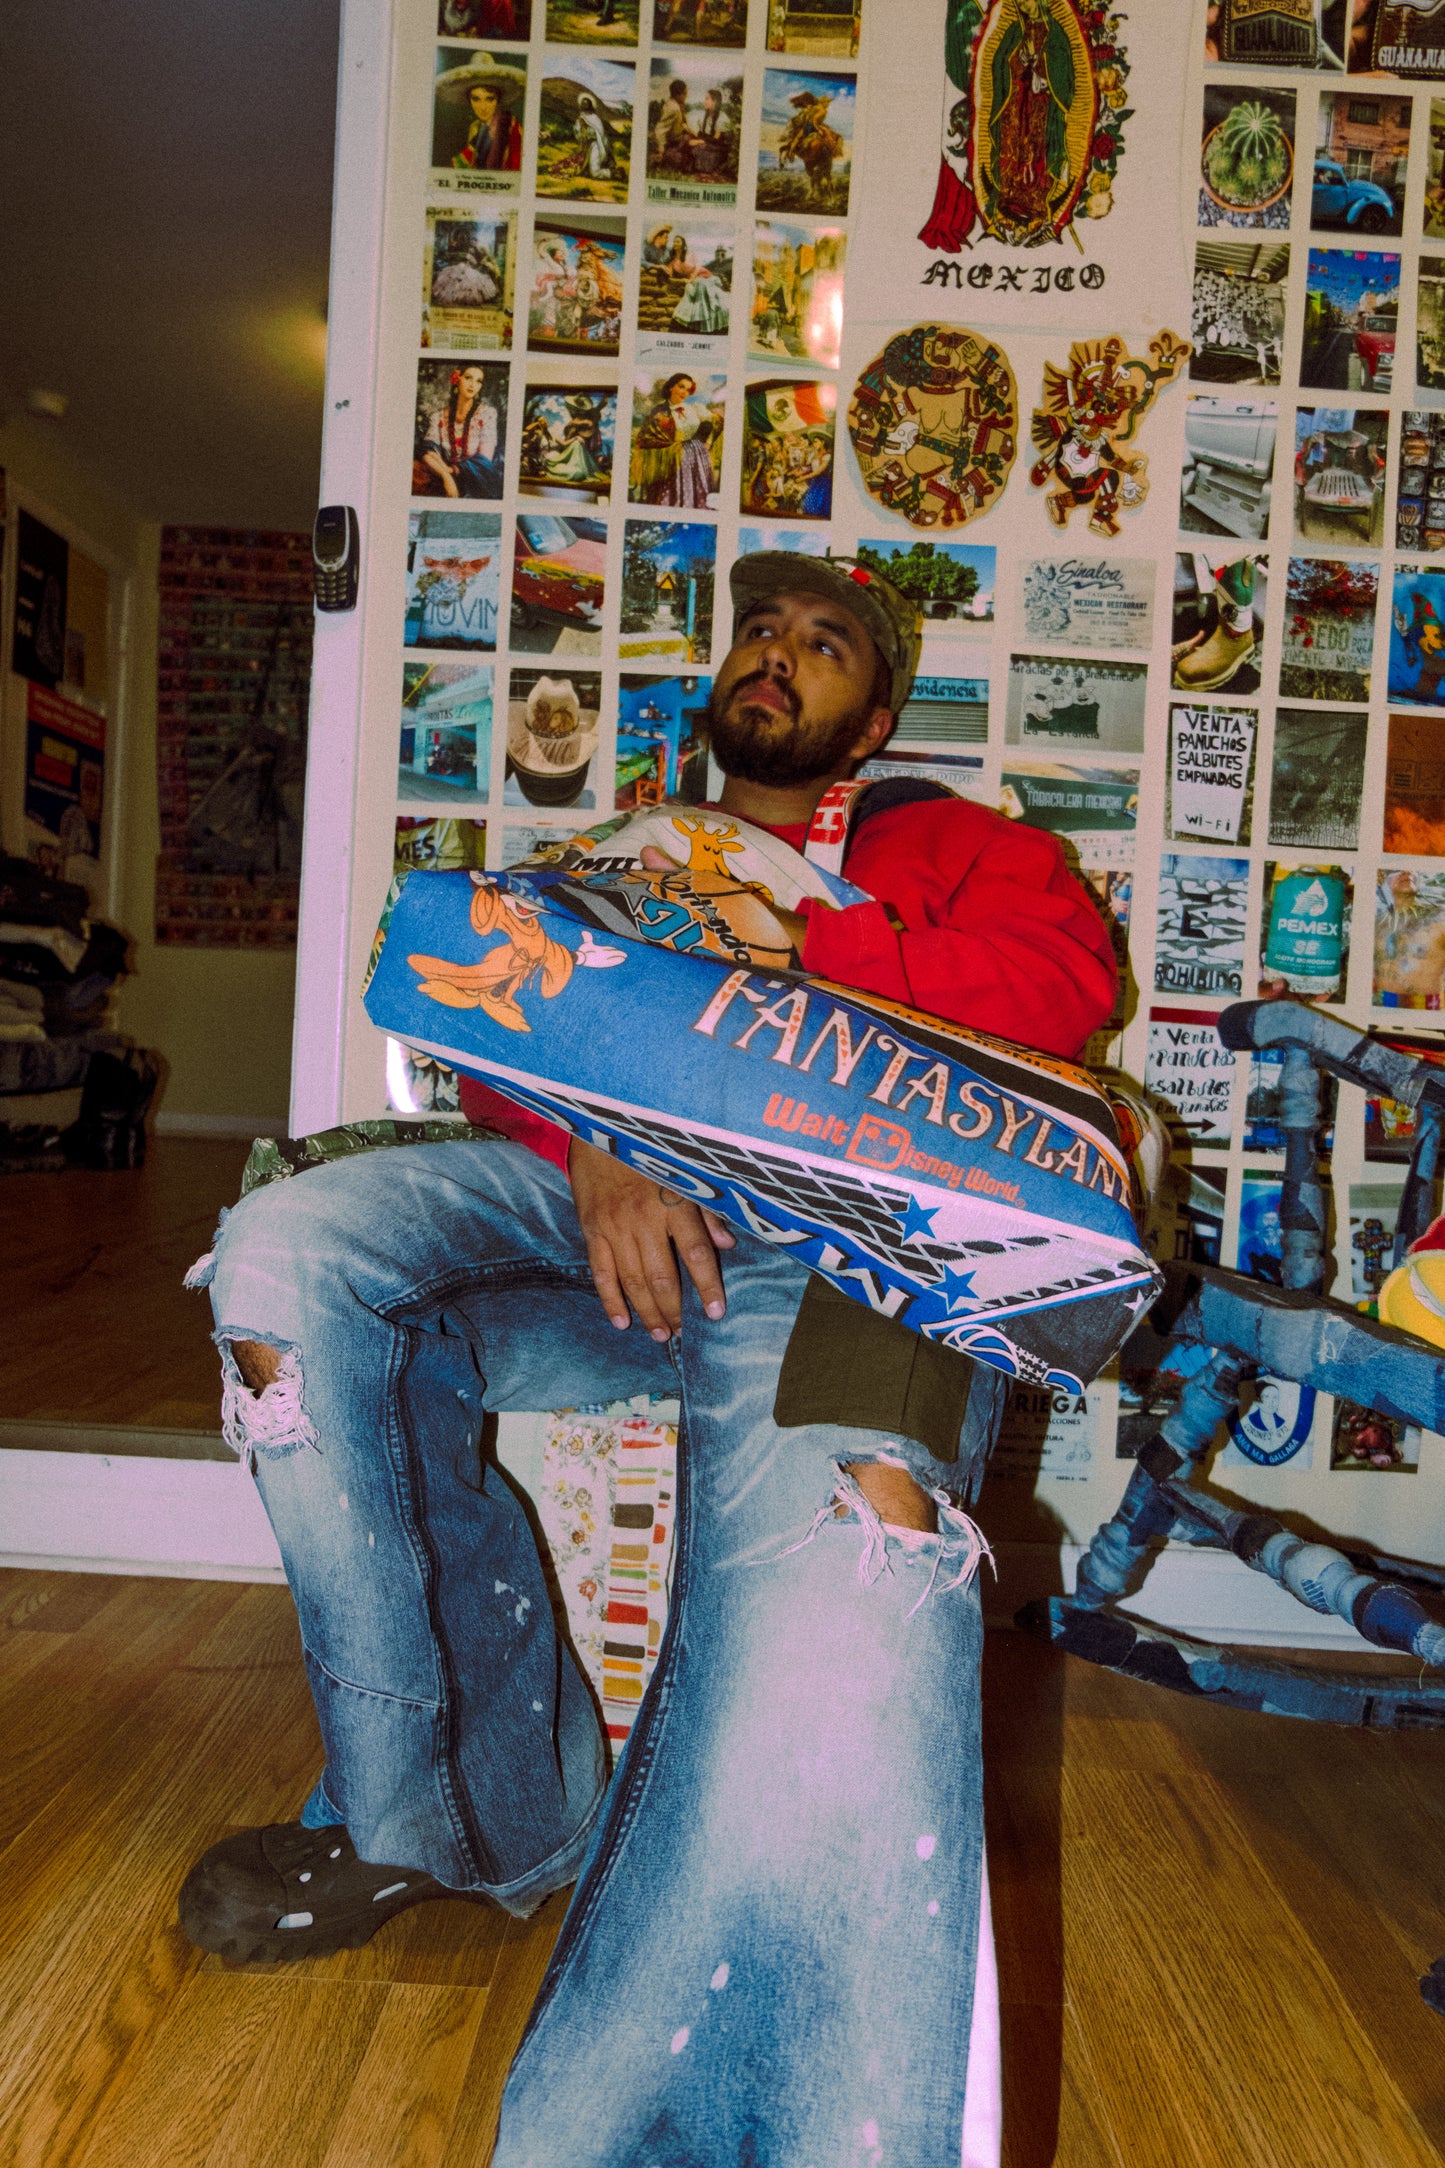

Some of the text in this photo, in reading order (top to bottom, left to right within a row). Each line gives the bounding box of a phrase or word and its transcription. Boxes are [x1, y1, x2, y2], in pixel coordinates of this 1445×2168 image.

[920, 259, 1105, 293] MEXICO
[1057, 560, 1123, 584] Sinaloa
[1073, 599, 1148, 609] MEXICAN RESTAURANT
[1184, 711, 1242, 734] VENTA
[1177, 733, 1247, 752] PANUCHOS
[1177, 751, 1243, 770] SALBUTES
[1026, 790, 1083, 808] TABACALERA
[1278, 918, 1338, 936] PEMEX
[763, 1093, 1021, 1202] Walt Disney World
